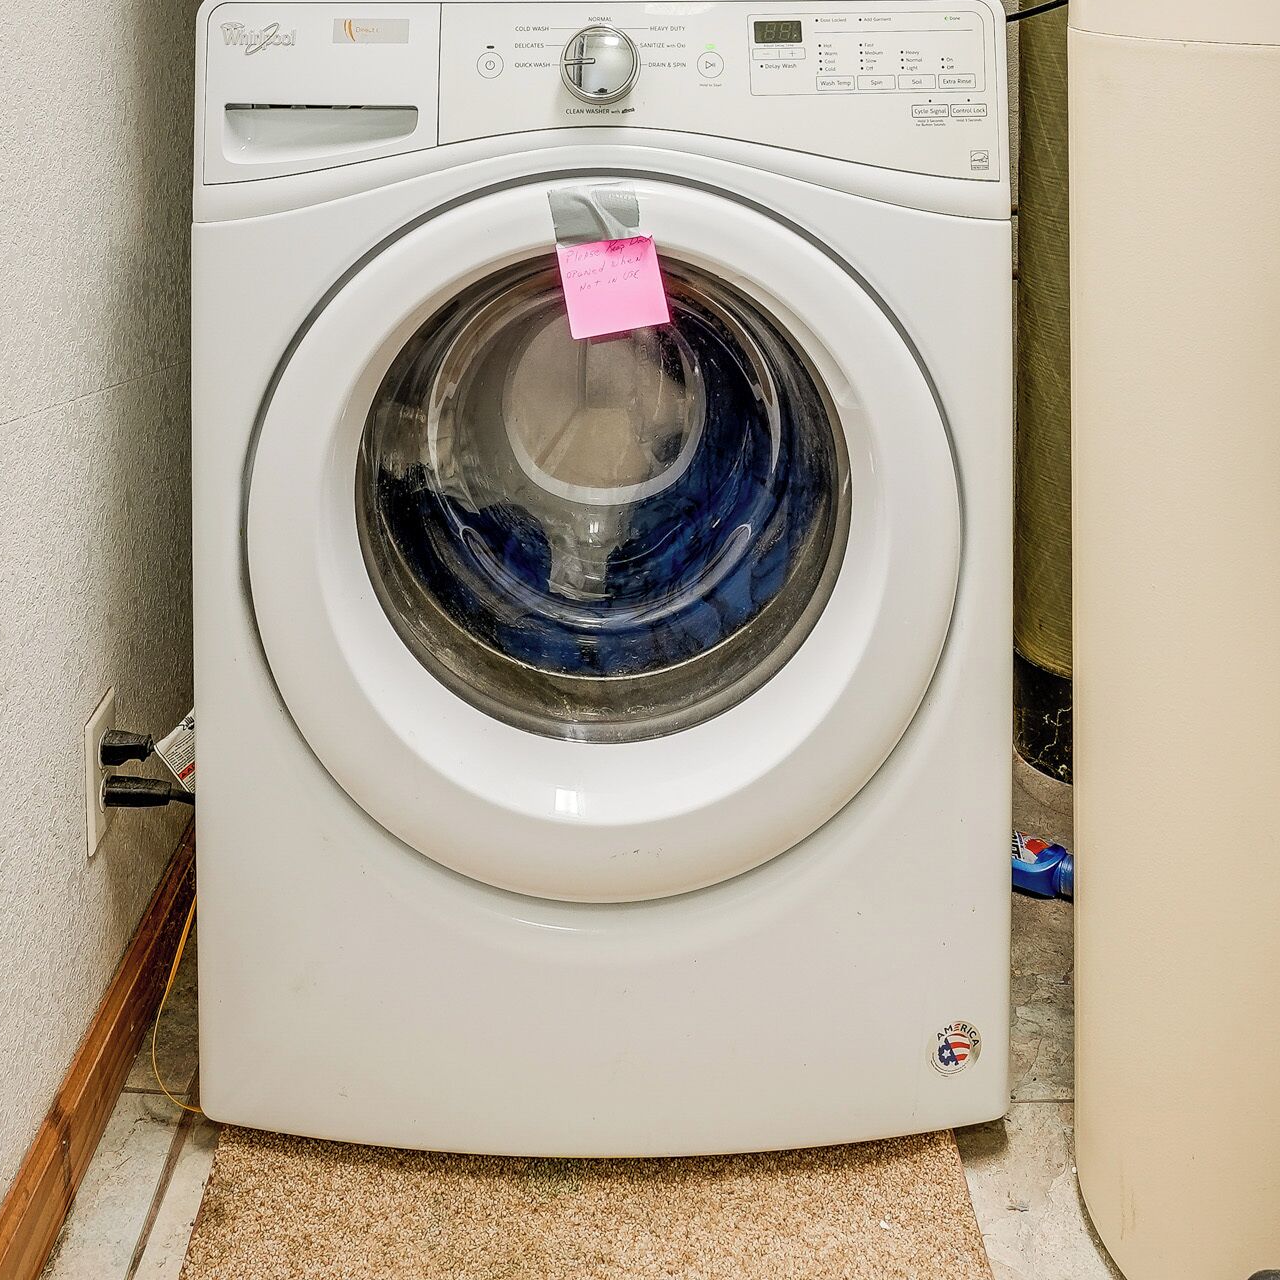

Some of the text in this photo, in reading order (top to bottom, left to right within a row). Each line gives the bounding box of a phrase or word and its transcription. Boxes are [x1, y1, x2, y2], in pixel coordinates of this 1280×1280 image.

[220, 22, 296, 56] Whirlpool
[835, 80, 851, 88] Temp
[914, 108, 947, 116] Cycle Signal
